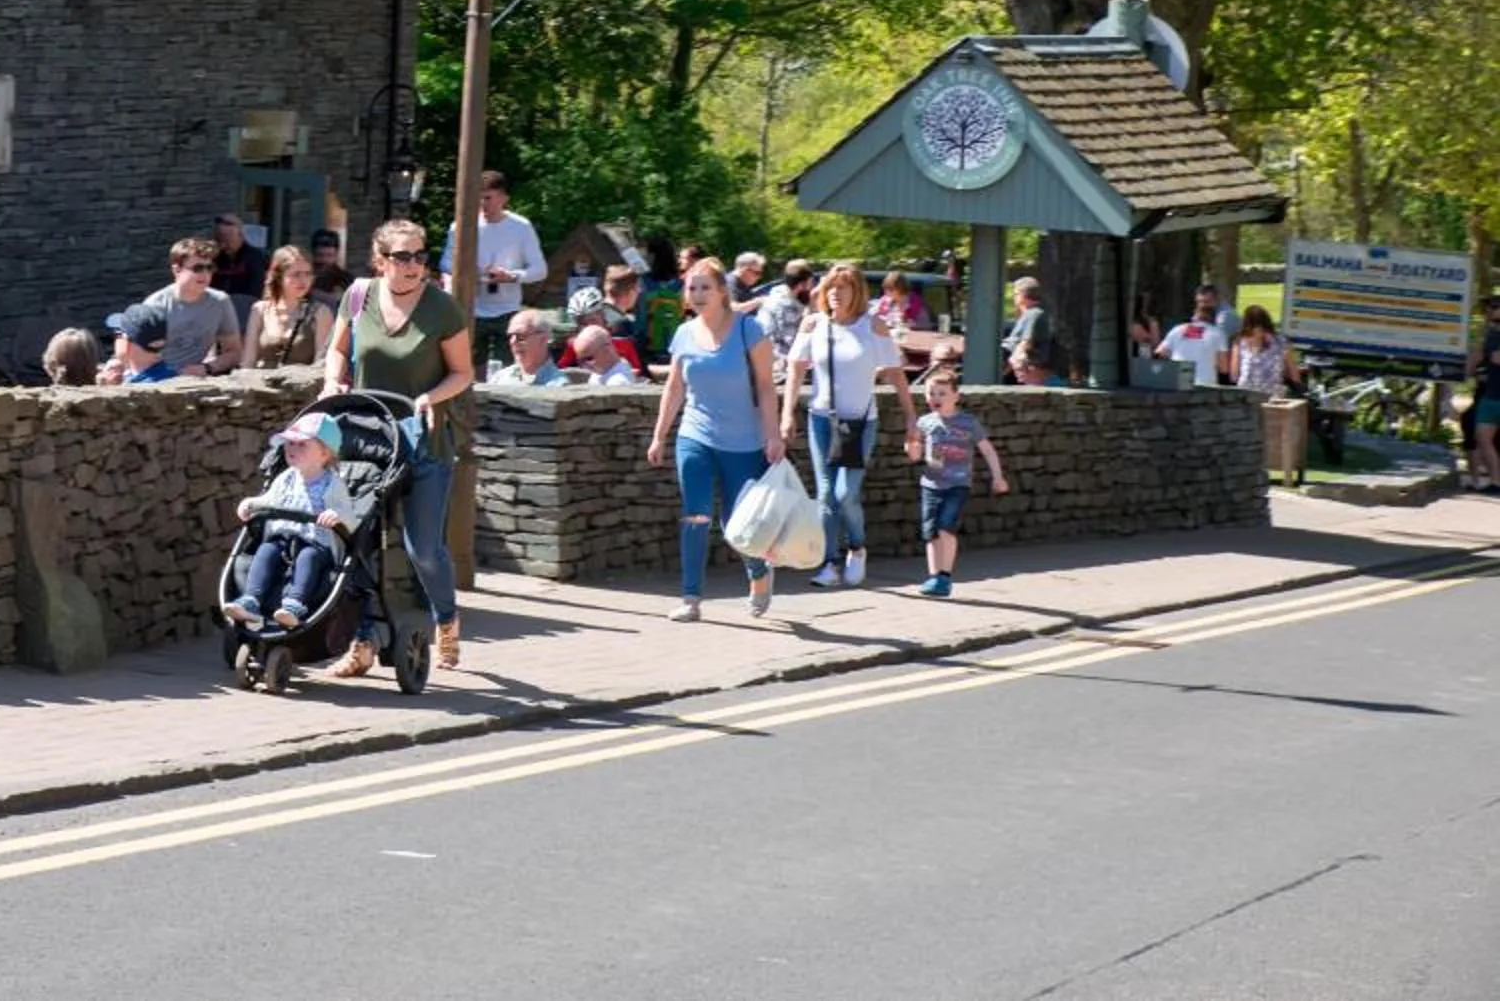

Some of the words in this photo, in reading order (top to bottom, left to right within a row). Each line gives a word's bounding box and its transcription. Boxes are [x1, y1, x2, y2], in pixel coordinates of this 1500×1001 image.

[946, 68, 991, 88] TREE
[1295, 253, 1363, 271] BALMAHA
[1390, 262, 1467, 282] BOATYARD
